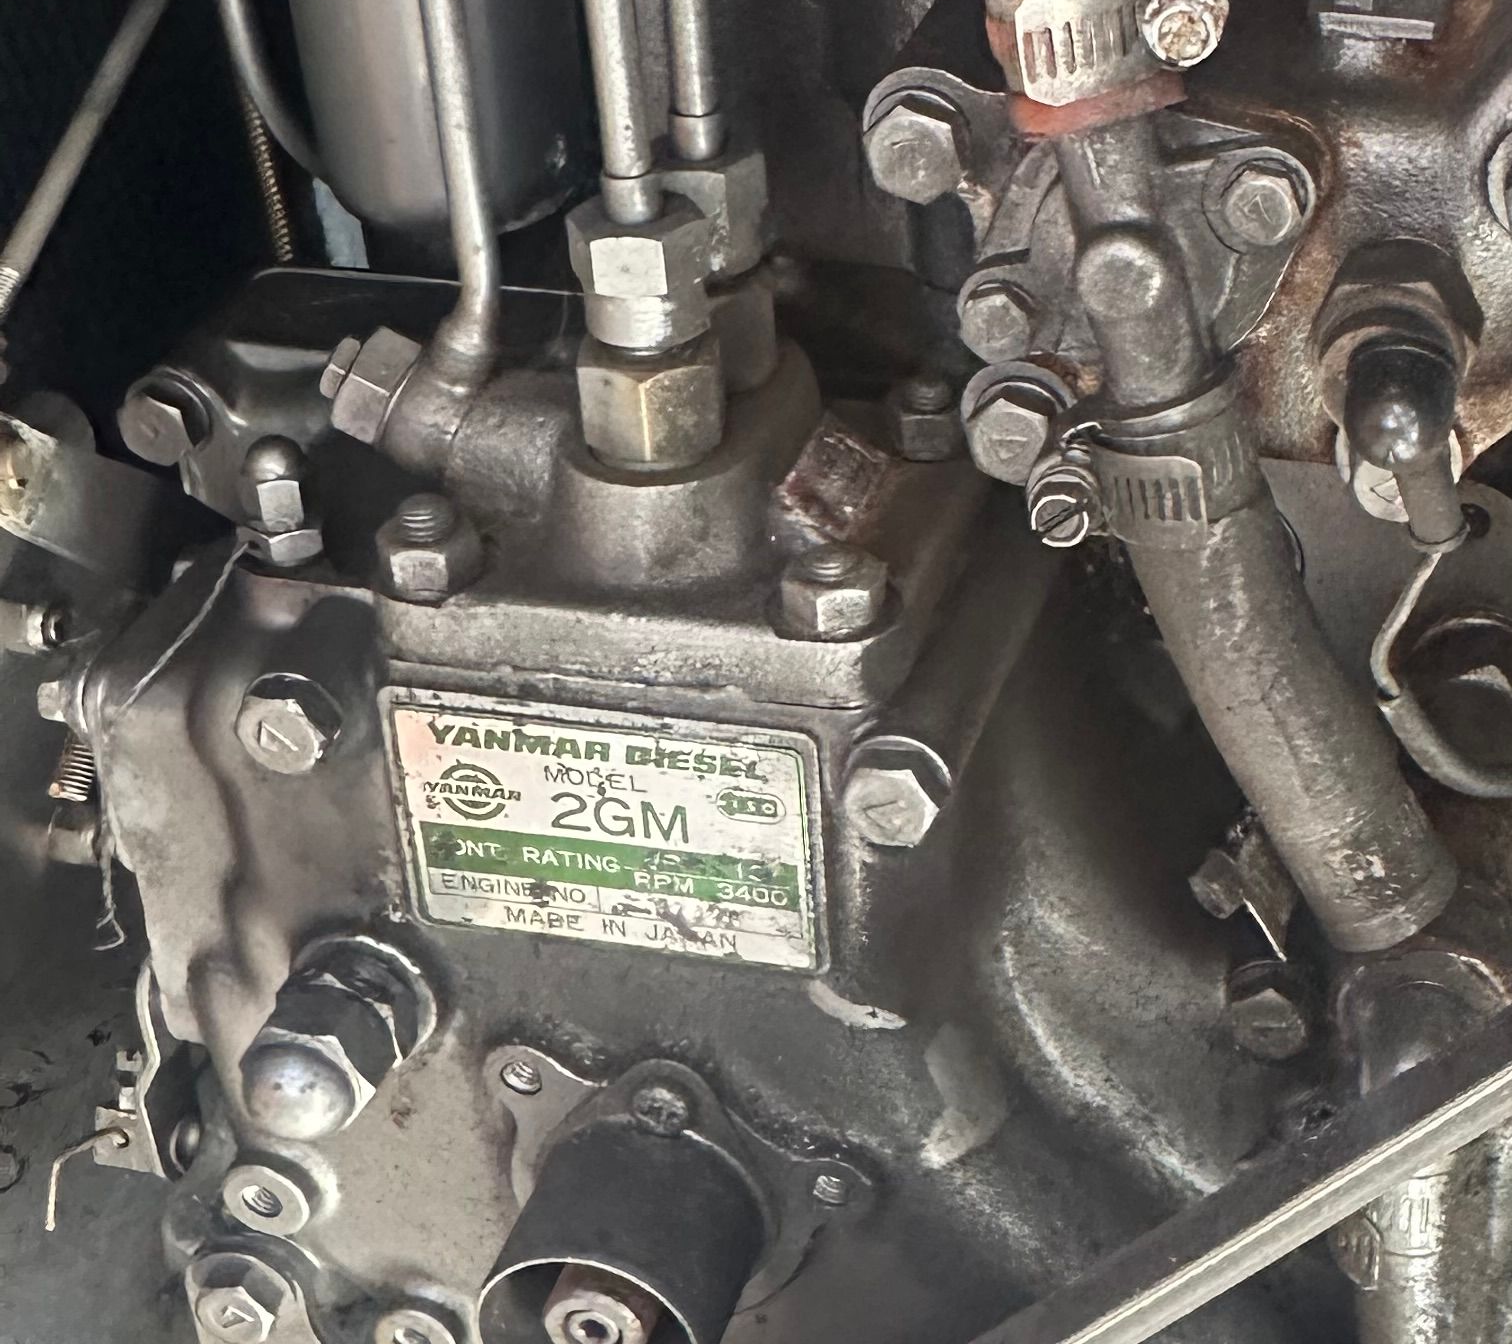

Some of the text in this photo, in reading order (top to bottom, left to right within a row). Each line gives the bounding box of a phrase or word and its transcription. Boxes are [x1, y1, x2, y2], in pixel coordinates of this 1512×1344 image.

[427, 718, 769, 784] YANMAR DIESEL
[422, 780, 522, 802] YANMAR
[550, 791, 690, 844] 2GM
[522, 845, 621, 874] RATING
[633, 870, 788, 907] RPM 3400
[601, 917, 627, 938] IN
[645, 922, 737, 949] JAAN
